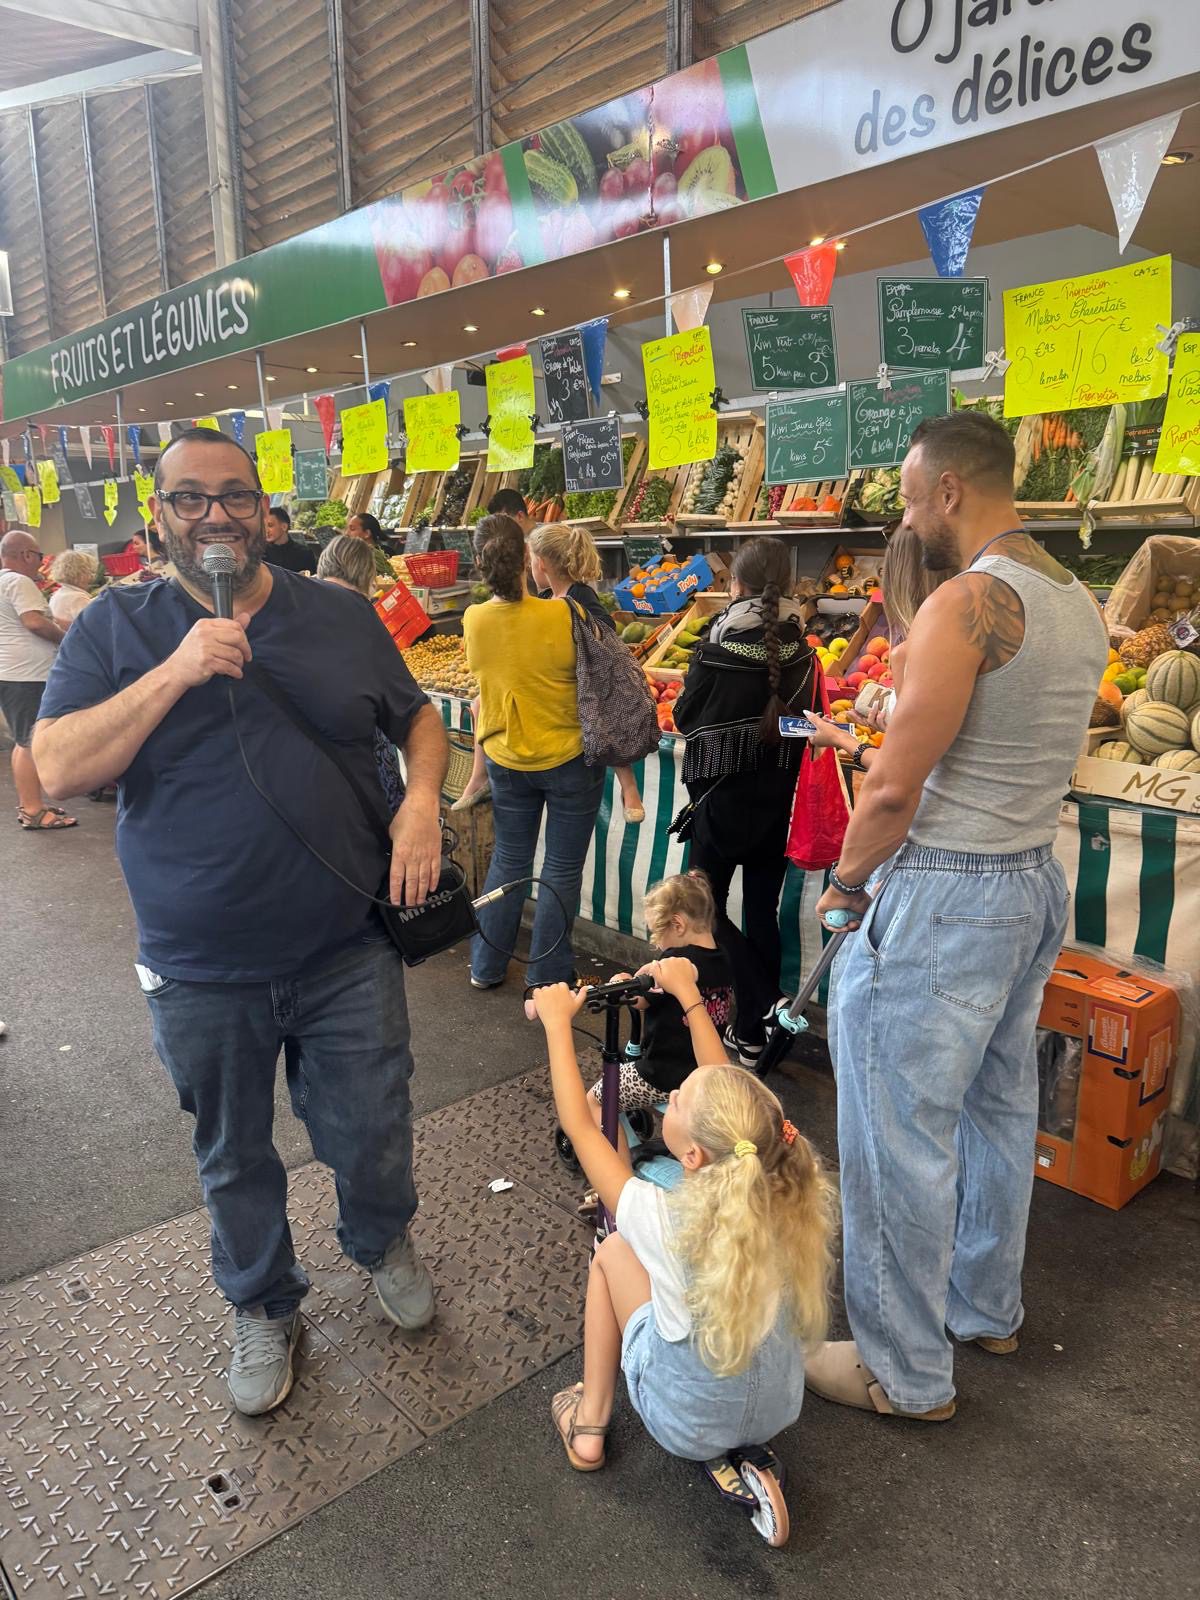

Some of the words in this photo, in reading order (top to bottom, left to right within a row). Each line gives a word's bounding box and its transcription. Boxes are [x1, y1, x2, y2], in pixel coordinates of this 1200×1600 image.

[854, 89, 936, 156] des
[951, 22, 1153, 125] délices
[1011, 287, 1046, 306] FRANCE
[1024, 308, 1062, 334] Melons
[1069, 296, 1127, 319] Charentais
[50, 333, 109, 395] FRUITS
[110, 326, 136, 374] ET
[139, 277, 250, 365] LÉGUMES
[762, 355, 776, 381] 5
